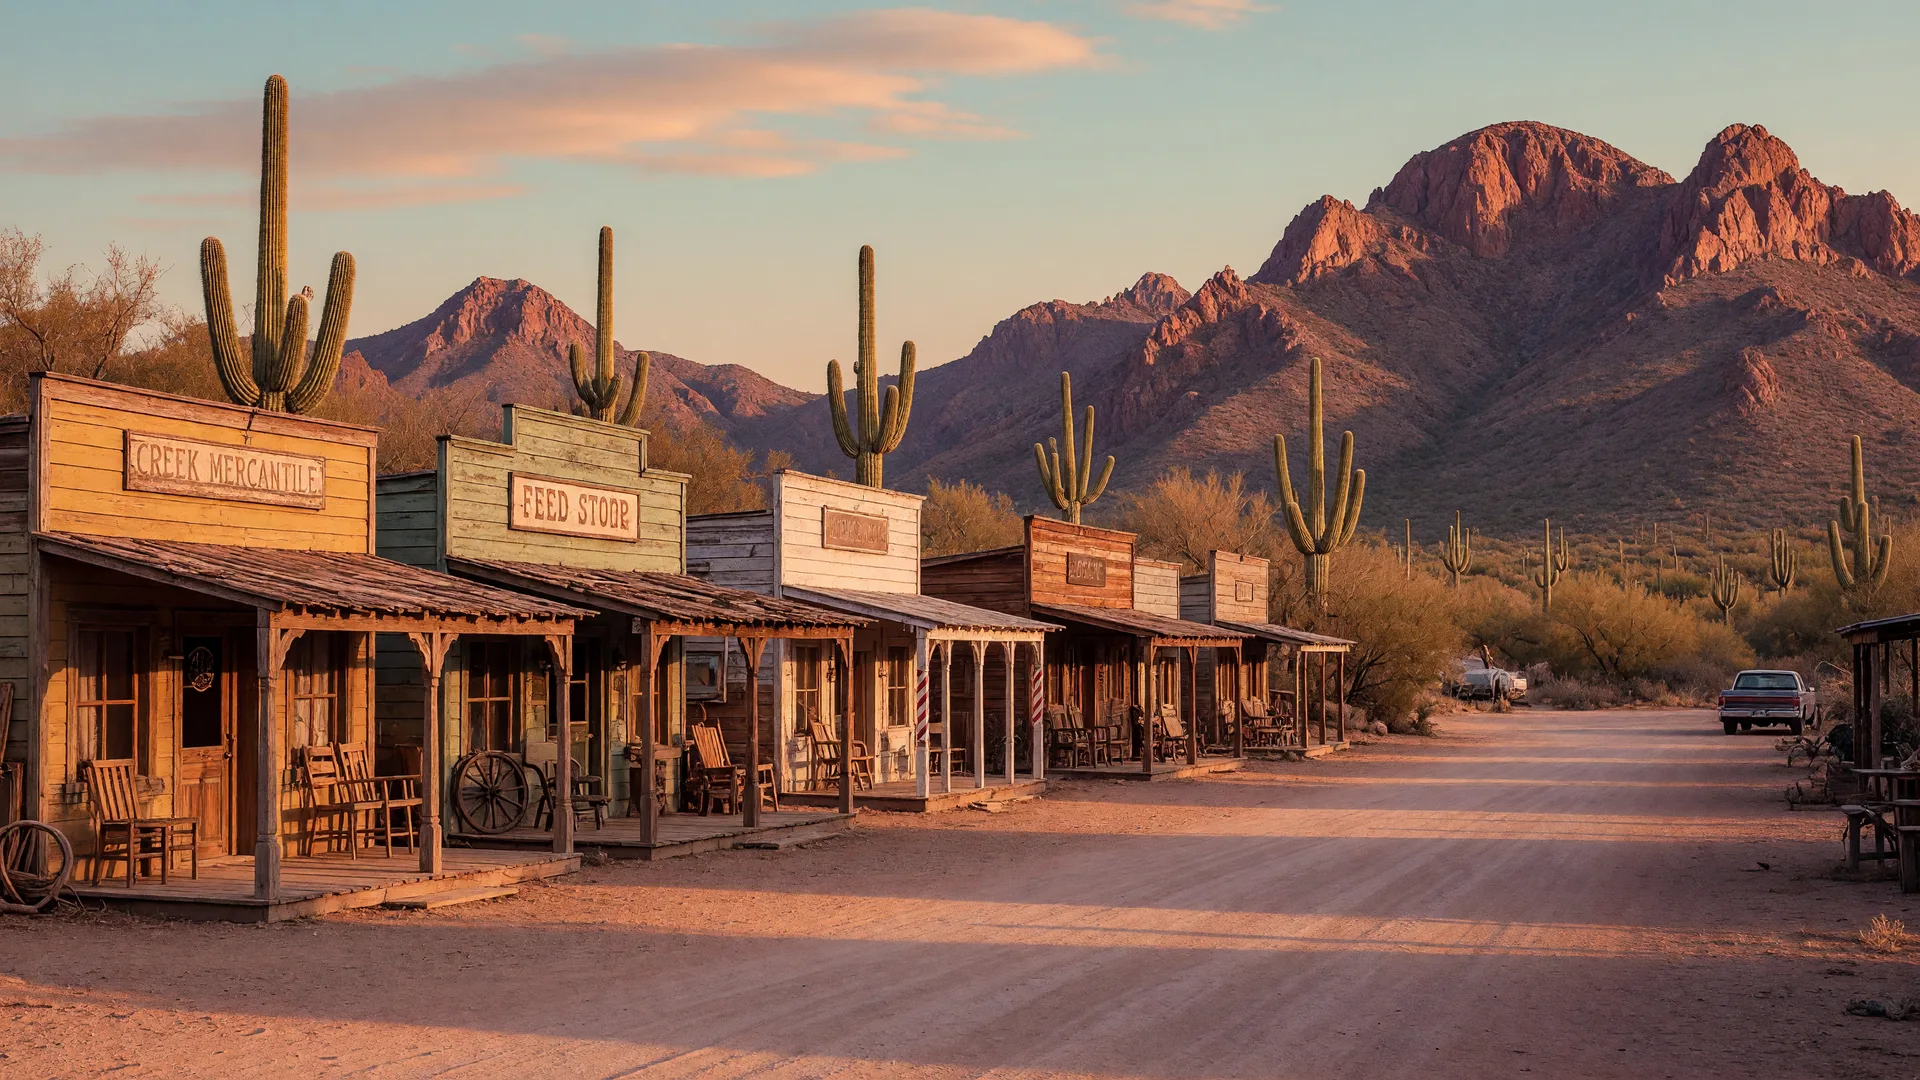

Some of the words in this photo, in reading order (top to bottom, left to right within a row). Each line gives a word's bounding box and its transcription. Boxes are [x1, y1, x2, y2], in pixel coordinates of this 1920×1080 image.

[136, 443, 200, 481] CREEK
[209, 452, 318, 493] MERCANTILE
[523, 485, 568, 522] FEED
